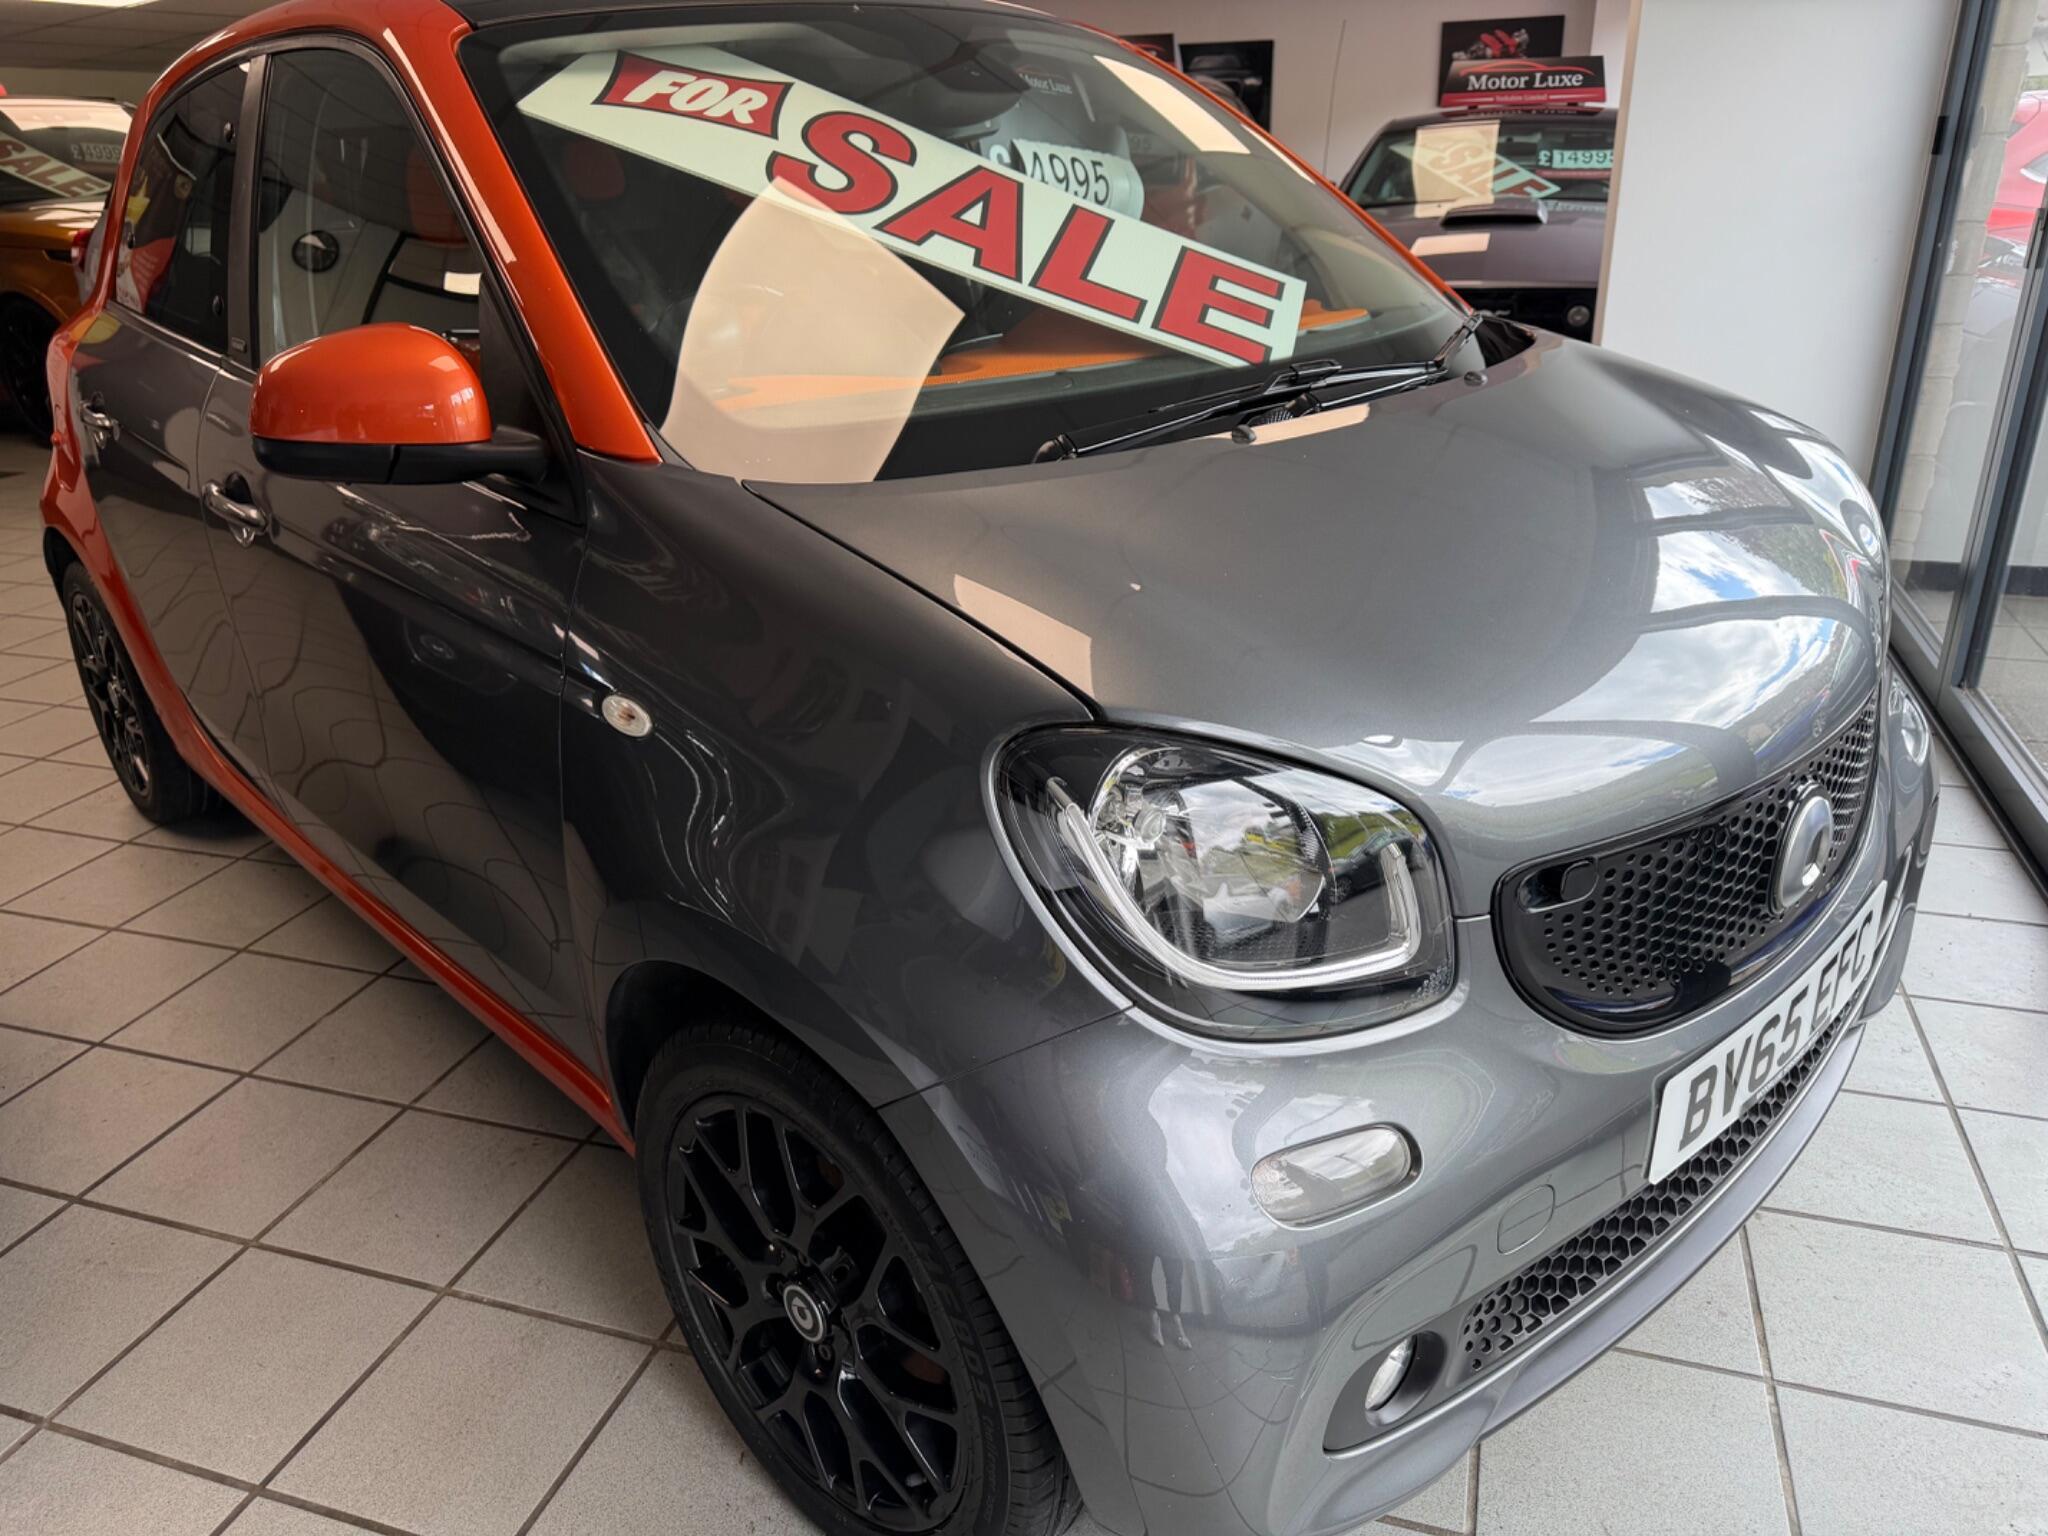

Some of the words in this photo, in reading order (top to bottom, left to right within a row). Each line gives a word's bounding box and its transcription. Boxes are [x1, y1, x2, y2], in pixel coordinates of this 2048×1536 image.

[1466, 73, 1530, 91] Motor
[1533, 72, 1584, 88] Luxe
[622, 69, 769, 125] FOR
[766, 111, 1285, 366] SALE
[1678, 984, 1809, 1152] BV65
[1812, 909, 1874, 1027] EFC
